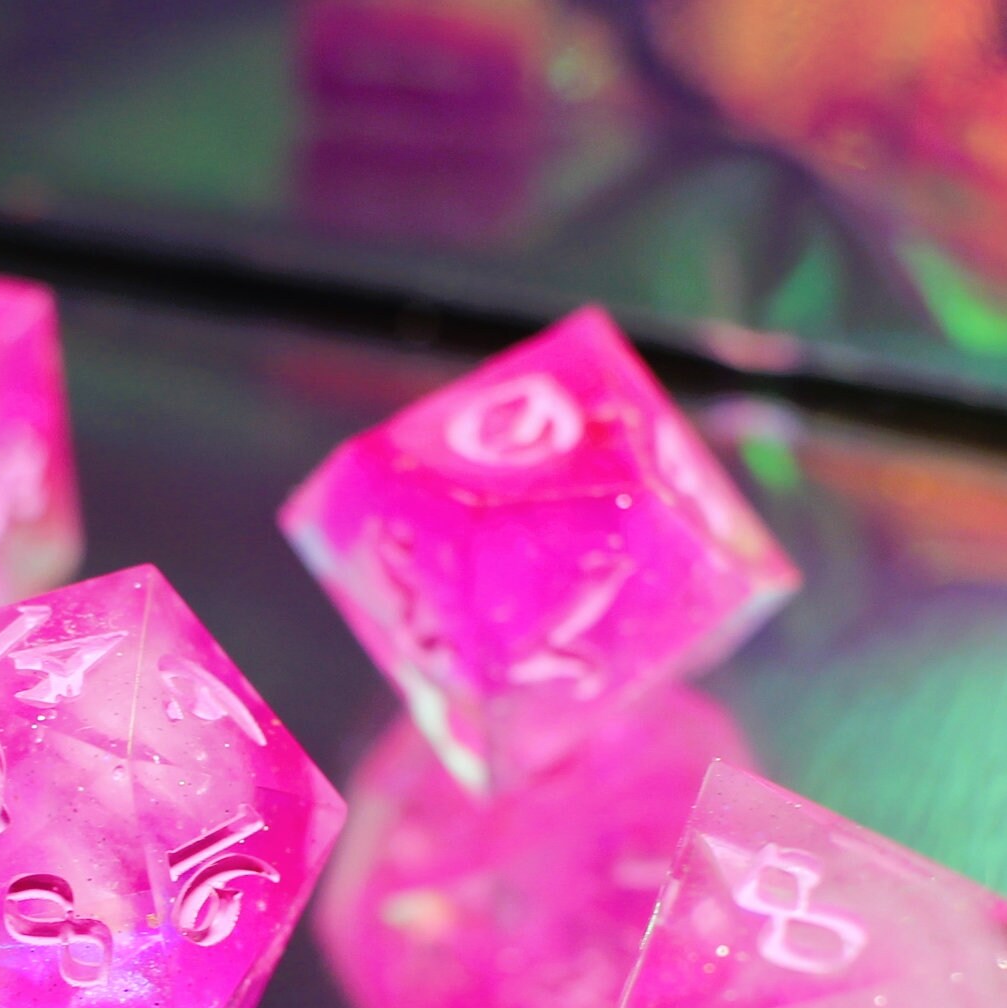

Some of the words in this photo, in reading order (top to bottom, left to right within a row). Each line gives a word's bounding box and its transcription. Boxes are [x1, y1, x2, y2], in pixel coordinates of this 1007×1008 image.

[4, 872, 114, 989] 8
[166, 803, 282, 947] 16
[732, 839, 870, 975] 8
